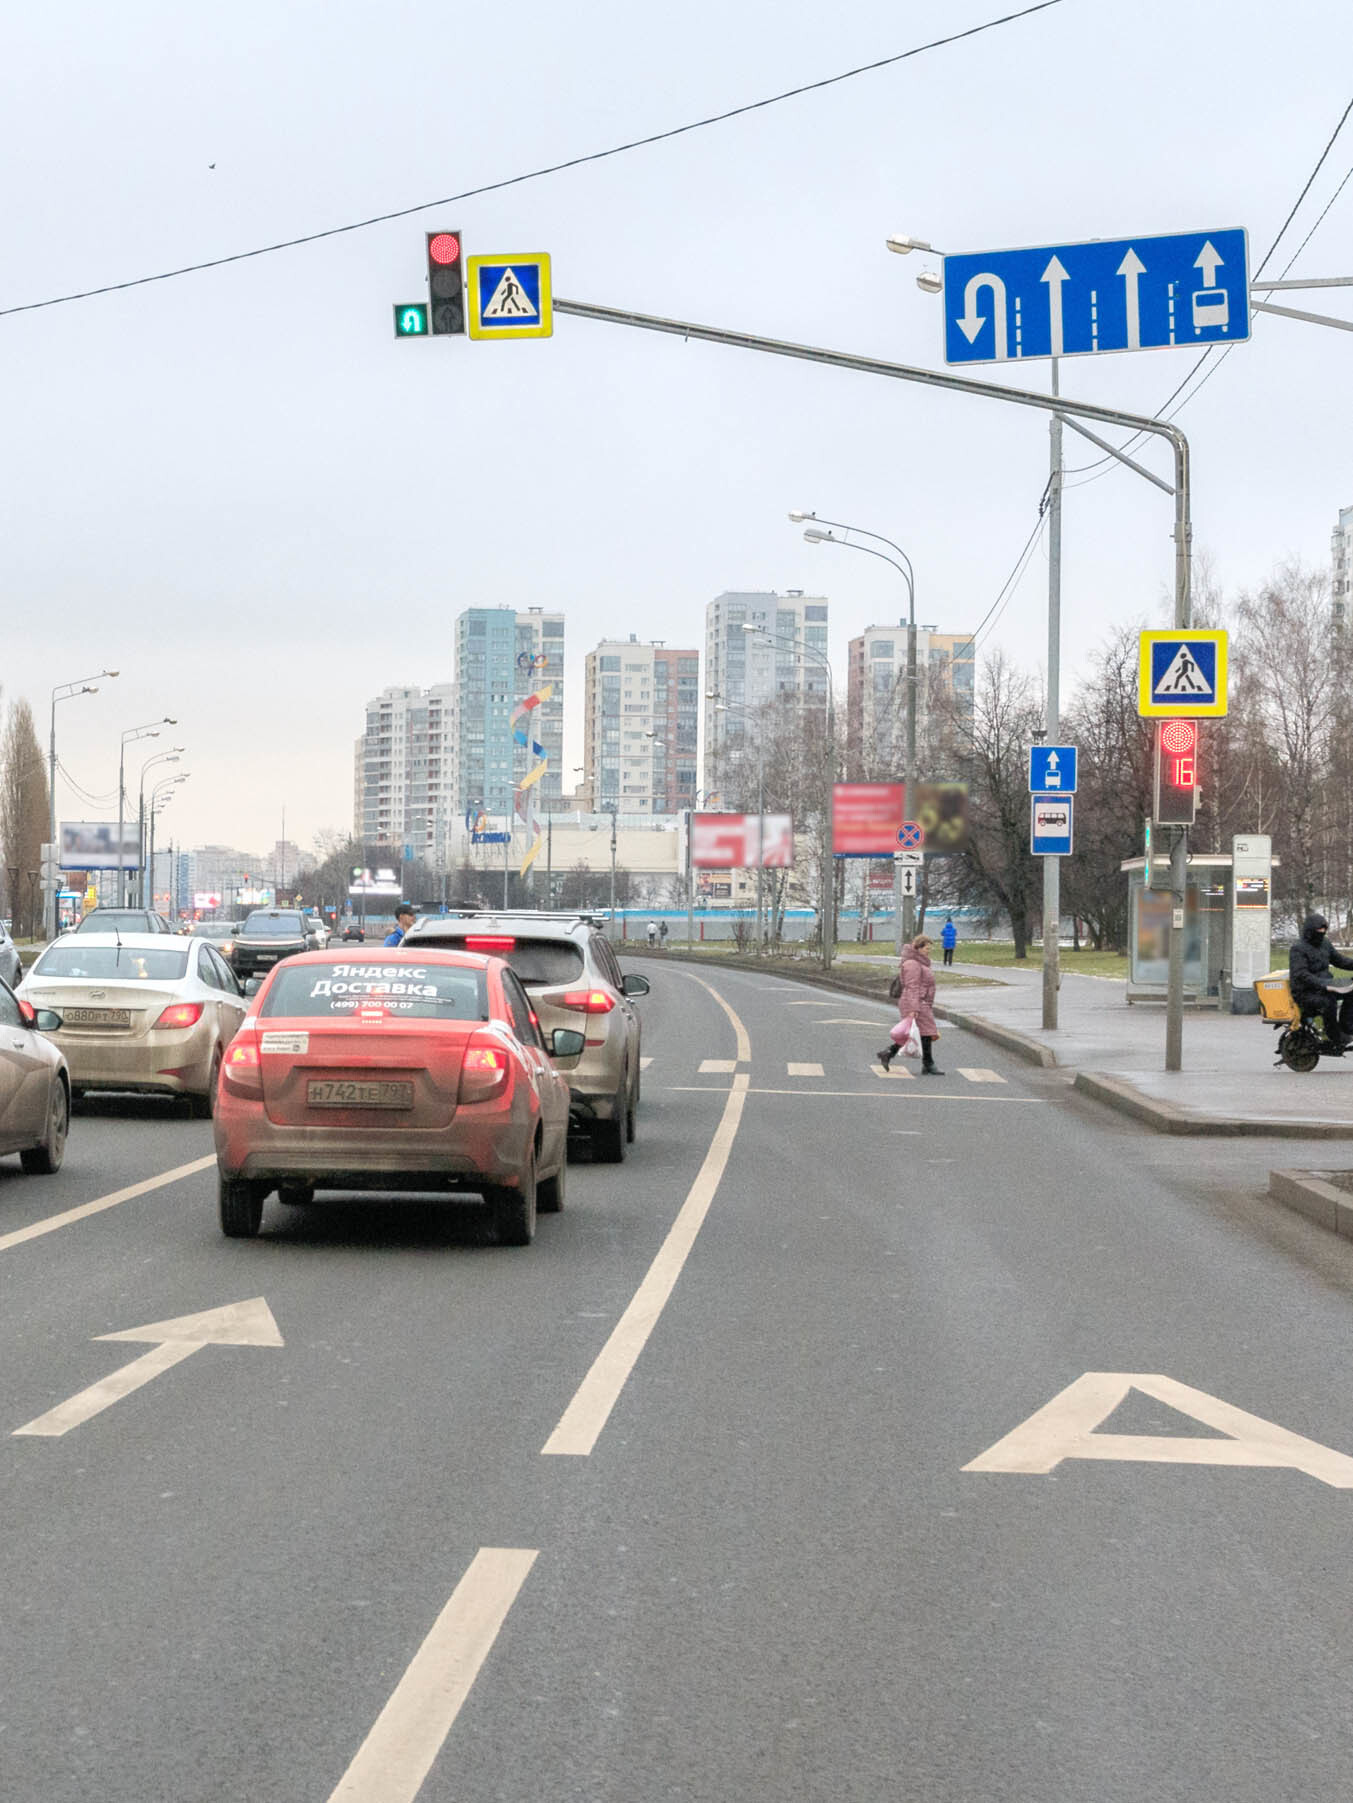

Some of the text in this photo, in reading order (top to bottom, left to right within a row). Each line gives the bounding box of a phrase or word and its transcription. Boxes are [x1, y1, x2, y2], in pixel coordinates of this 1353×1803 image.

[1176, 758, 1193, 785] 16
[332, 965, 428, 979] Яндекс
[310, 980, 438, 998] Доставка
[330, 1000, 359, 1009] (499)
